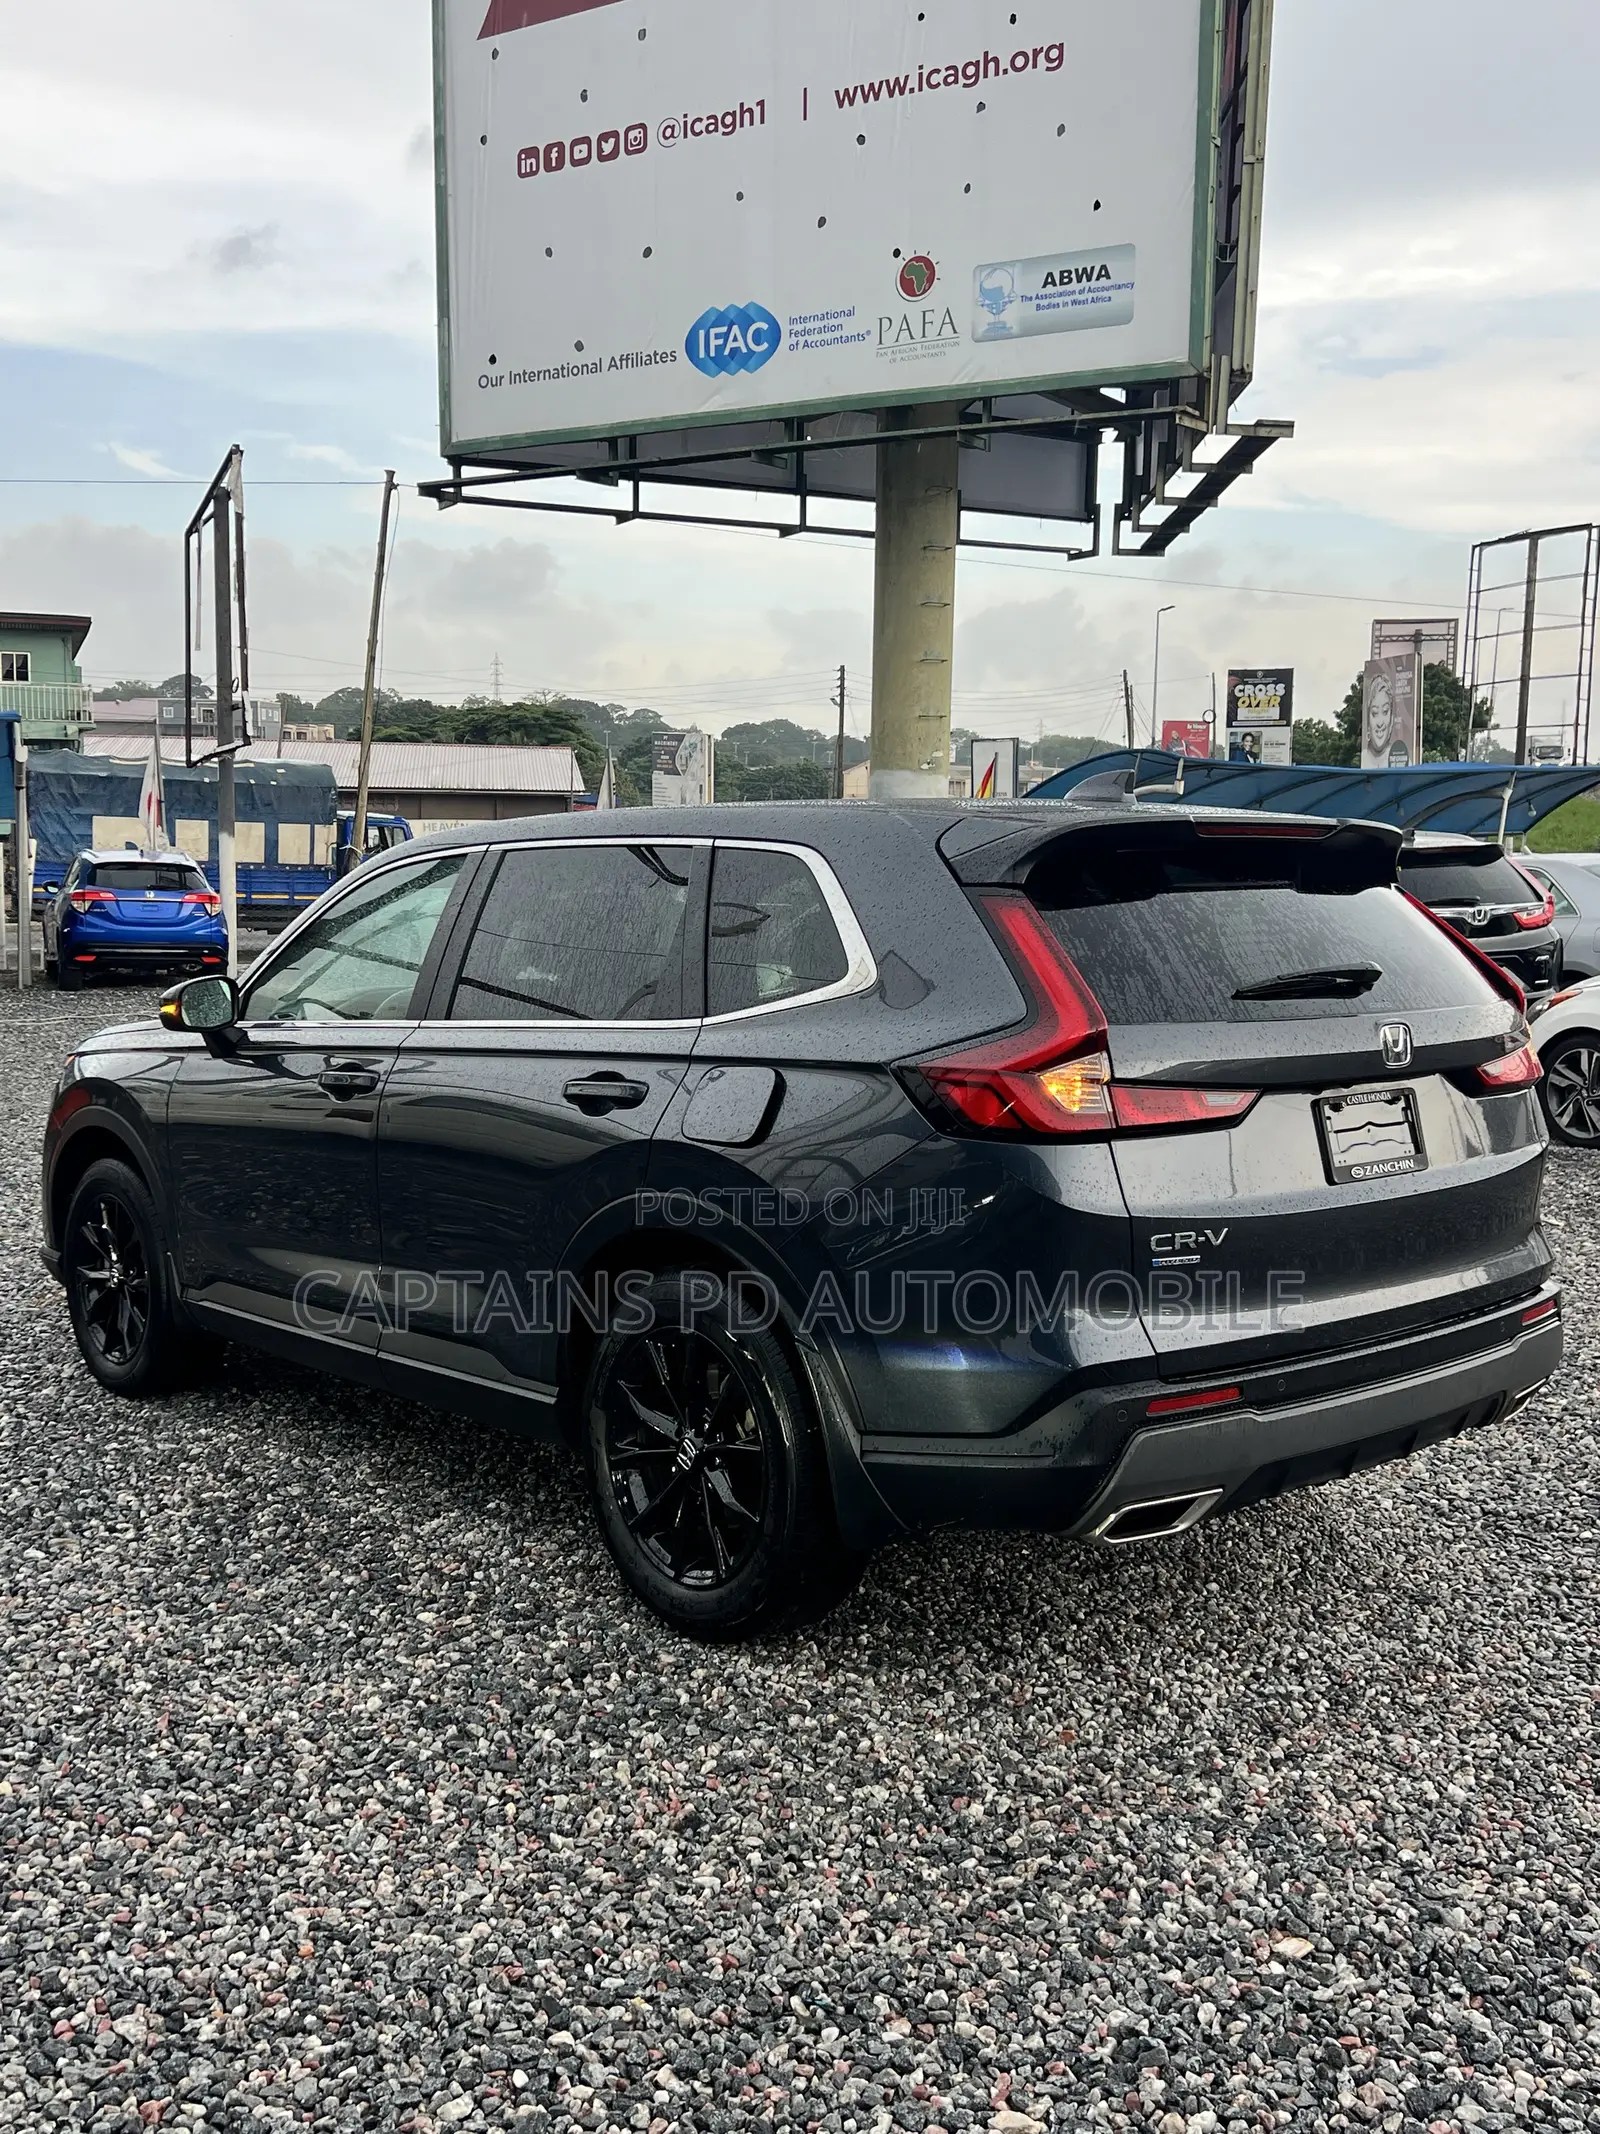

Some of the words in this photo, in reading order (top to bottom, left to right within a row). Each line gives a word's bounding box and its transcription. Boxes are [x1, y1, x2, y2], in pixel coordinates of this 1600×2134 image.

[834, 42, 1065, 109] www.icagh.org
[657, 99, 766, 148] @icagh1
[1041, 264, 1112, 289] ABWA
[1021, 294, 1033, 303] The
[1034, 289, 1077, 301] Association
[1078, 286, 1086, 295] of
[1087, 281, 1135, 294] Accountancy
[1035, 302, 1060, 312] Bodies
[1062, 300, 1069, 308] in
[1071, 298, 1089, 307] West
[1090, 295, 1112, 305] Africa
[788, 305, 856, 326] International
[876, 306, 959, 346] PAFA
[698, 322, 769, 359] IFAC
[788, 322, 843, 339] Federation
[788, 340, 800, 351] of
[477, 374, 505, 389] Our
[508, 357, 603, 386] International
[607, 348, 678, 373] Affiliates
[1234, 683, 1286, 697] CROSS
[1237, 695, 1281, 708] OVER
[1346, 1095, 1369, 1105] CASTLE
[1369, 1092, 1392, 1103] HONDA
[1364, 1159, 1415, 1176] ZANCHIN
[1150, 1228, 1229, 1252] CR-V
